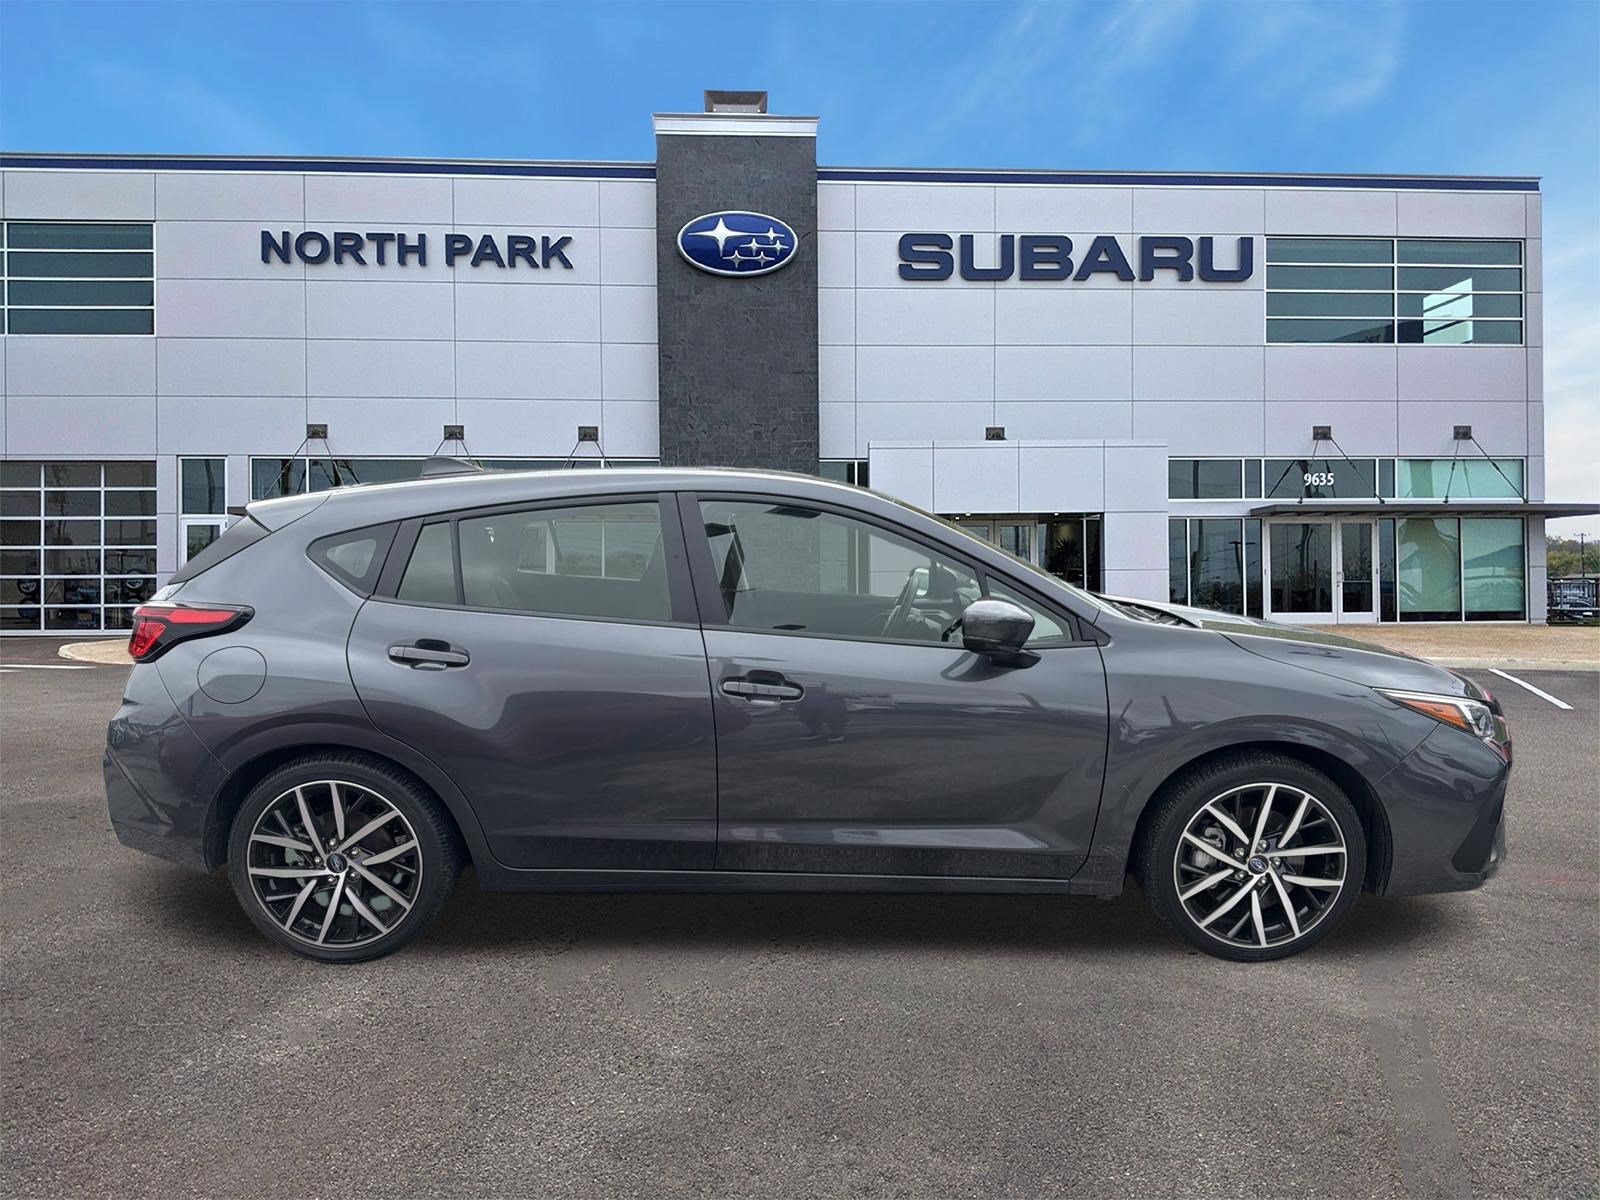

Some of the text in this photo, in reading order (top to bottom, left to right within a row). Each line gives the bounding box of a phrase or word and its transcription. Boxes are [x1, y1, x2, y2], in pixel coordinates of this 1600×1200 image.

[260, 230, 574, 269] NORTH PARK
[897, 233, 1254, 282] SUBARU
[1303, 472, 1335, 487] 9635
